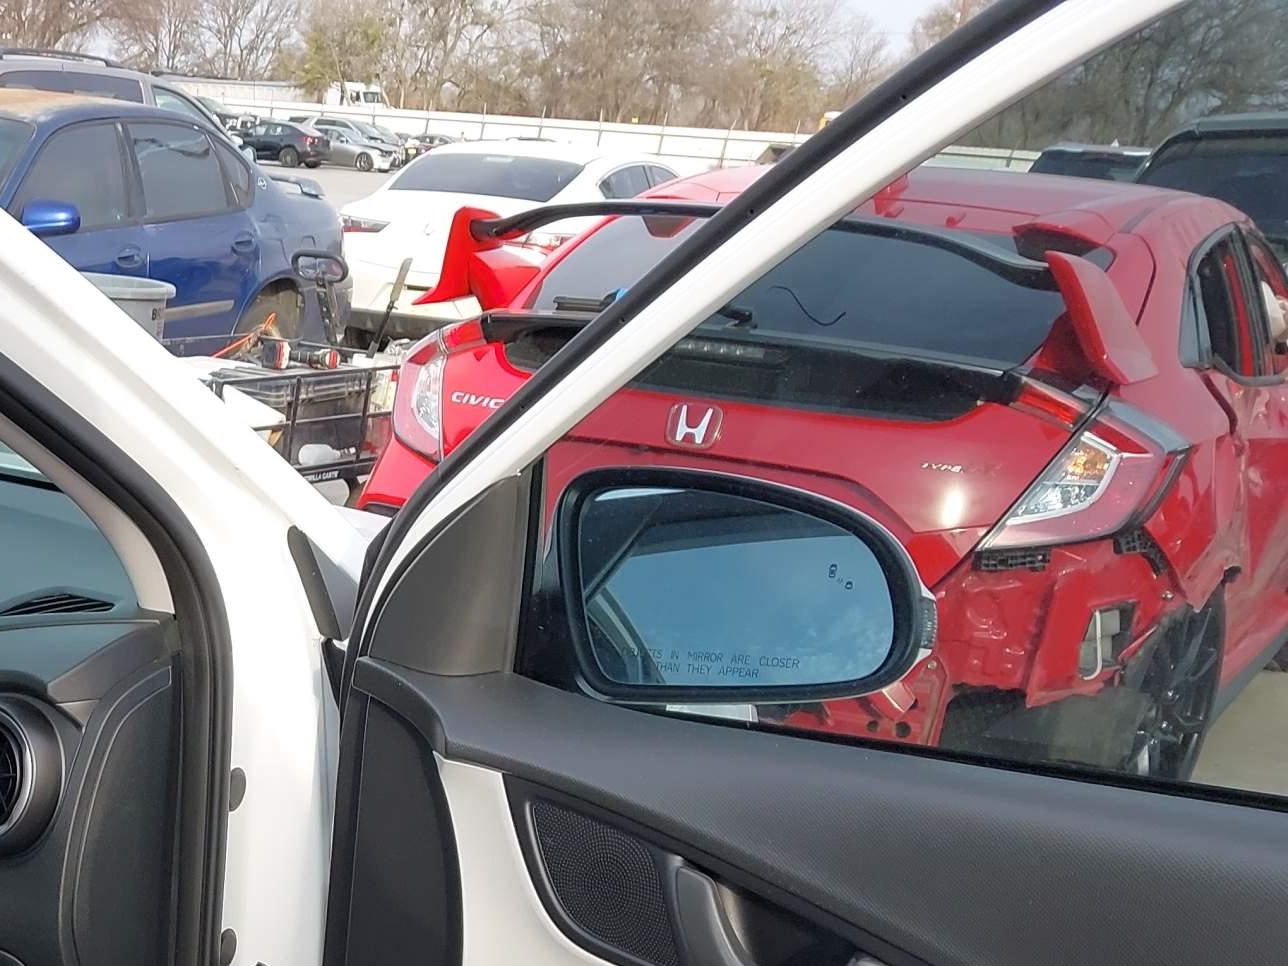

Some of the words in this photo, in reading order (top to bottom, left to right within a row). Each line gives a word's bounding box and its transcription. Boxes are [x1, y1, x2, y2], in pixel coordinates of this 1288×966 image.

[451, 391, 505, 409] CIVIC
[669, 649, 680, 660] IN
[687, 650, 723, 663] MIRROR
[730, 653, 751, 665] ARE
[759, 655, 801, 669] CLOSER
[656, 662, 681, 674] THAN
[687, 663, 712, 675] THEY
[718, 665, 760, 679] APPEAR
